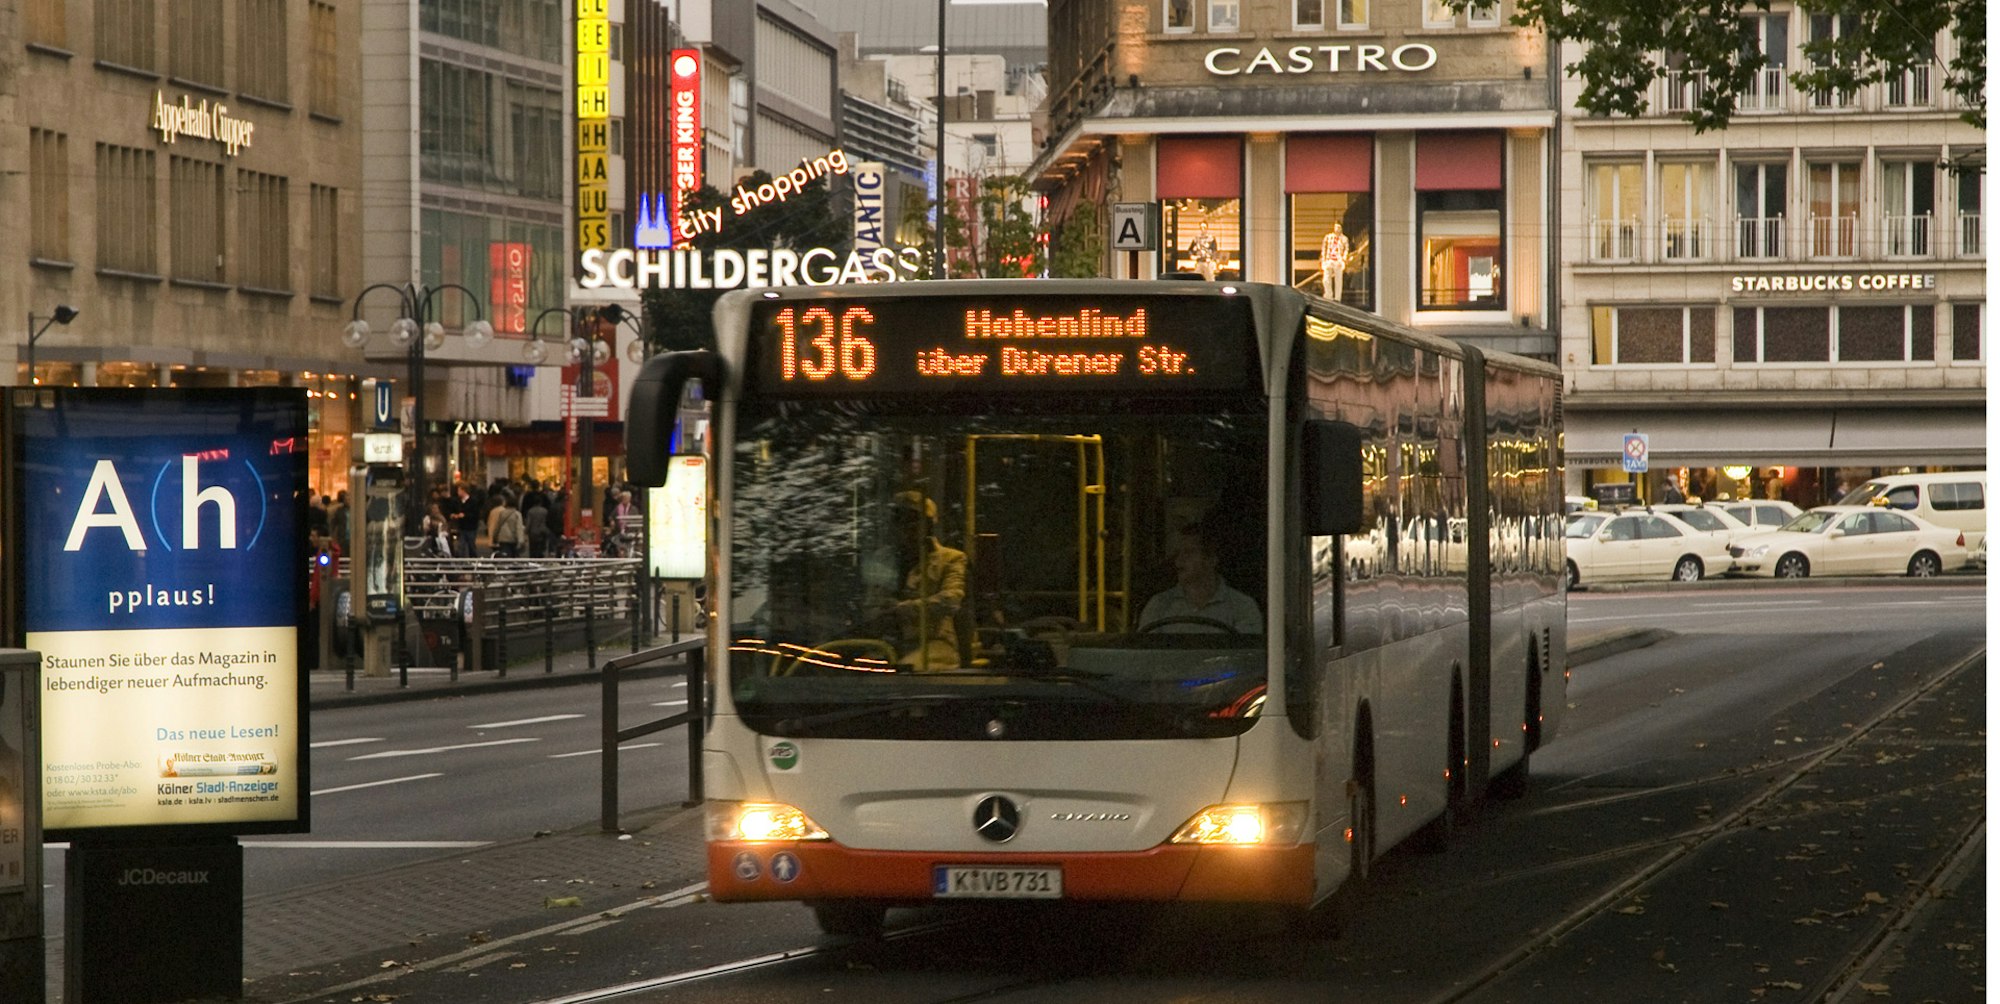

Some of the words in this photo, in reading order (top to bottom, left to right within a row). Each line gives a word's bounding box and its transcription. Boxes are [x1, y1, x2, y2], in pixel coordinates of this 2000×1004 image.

[1203, 43, 1438, 75] CASTRO
[153, 88, 211, 144] Appelrath
[212, 101, 254, 156] Cüpper
[677, 91, 694, 143] KING
[680, 206, 722, 239] city
[731, 148, 849, 216] shopping
[1117, 217, 1142, 244] A
[1732, 275, 1853, 291] STARBUCKS
[1858, 274, 1936, 290] COFFEE
[776, 307, 876, 381] 136
[965, 308, 1146, 338] Hohenlind
[916, 347, 988, 375] über
[1002, 346, 1124, 375] Dürener
[1138, 345, 1196, 375] Str.
[377, 387, 389, 422] U
[454, 421, 500, 434] ZARA
[109, 584, 215, 613] pplaus!
[46, 655, 105, 669] Staunen
[109, 653, 130, 667] Sie
[134, 652, 167, 667] über
[170, 652, 195, 666] das
[198, 651, 260, 669] Magazin
[263, 650, 277, 663] in
[46, 676, 124, 694] lebendiger
[127, 678, 169, 689] neuer
[172, 672, 268, 690] Aufmachung.
[157, 728, 185, 741] Das
[189, 728, 226, 739] neue
[231, 724, 279, 738] Lesen!
[47, 762, 95, 771] Kostenloses
[47, 788, 66, 797] oder
[157, 783, 193, 795] Kölner
[196, 780, 279, 793] Stadt-Anzeiger
[118, 868, 209, 886] JCDecaux
